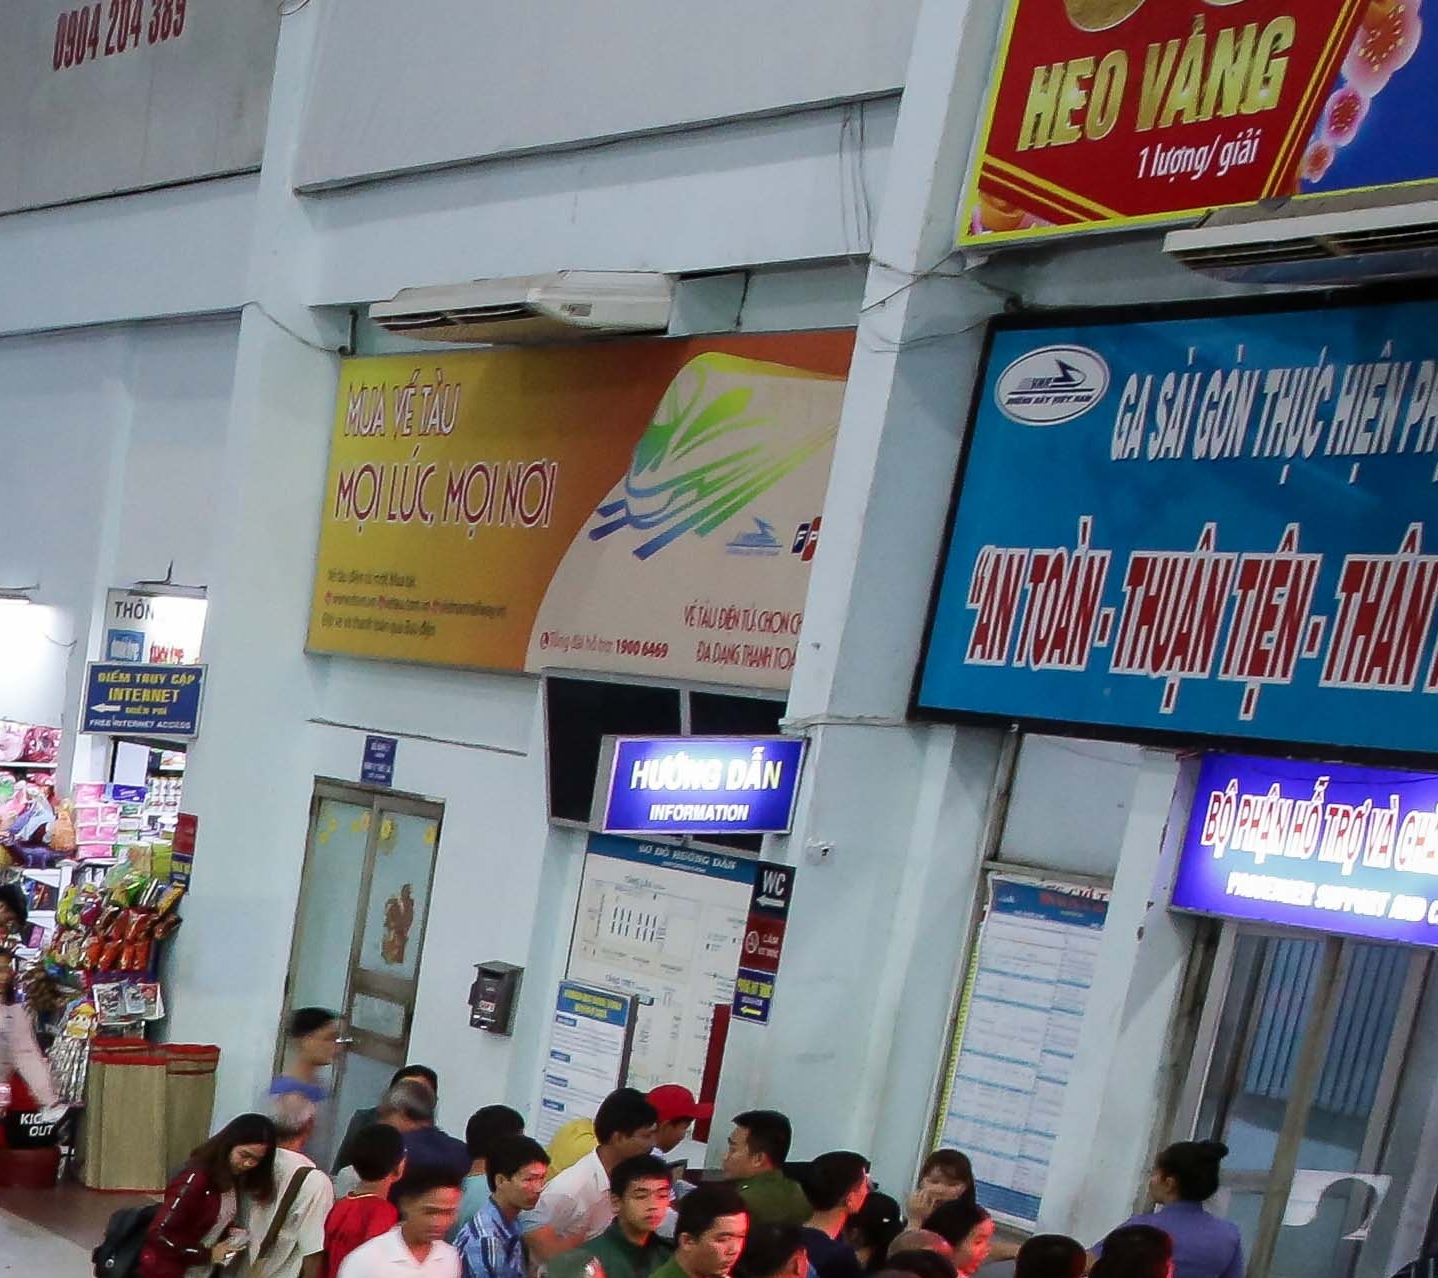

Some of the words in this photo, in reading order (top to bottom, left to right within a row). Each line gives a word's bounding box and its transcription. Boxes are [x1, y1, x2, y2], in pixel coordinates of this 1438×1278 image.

[53, 3, 103, 72] 0904
[104, 0, 145, 57] 204
[1016, 49, 1129, 151] HEO
[1135, 13, 1297, 132] VÀNG
[1138, 148, 1150, 179] 1
[1217, 127, 1263, 178] giải
[344, 382, 387, 438] MUA
[389, 368, 420, 438] VÉ
[417, 367, 463, 438] TÀU
[1112, 373, 1154, 461] GA
[1325, 340, 1412, 485] HIỆN
[334, 460, 385, 535] MỌI
[442, 459, 500, 540] MỌI
[1109, 522, 1241, 714] THUẬN
[1218, 522, 1325, 720] TIỆN
[108, 688, 180, 705] INTERNET
[724, 745, 784, 791] DẪN
[648, 803, 750, 822] INFORMATION
[1200, 777, 1239, 860] BỘ
[1230, 782, 1295, 865] PHẬN
[1283, 776, 1330, 861] HỖ
[1362, 794, 1401, 870] VÀ
[763, 869, 786, 897] WC
[29, 1124, 55, 1137] OUT
